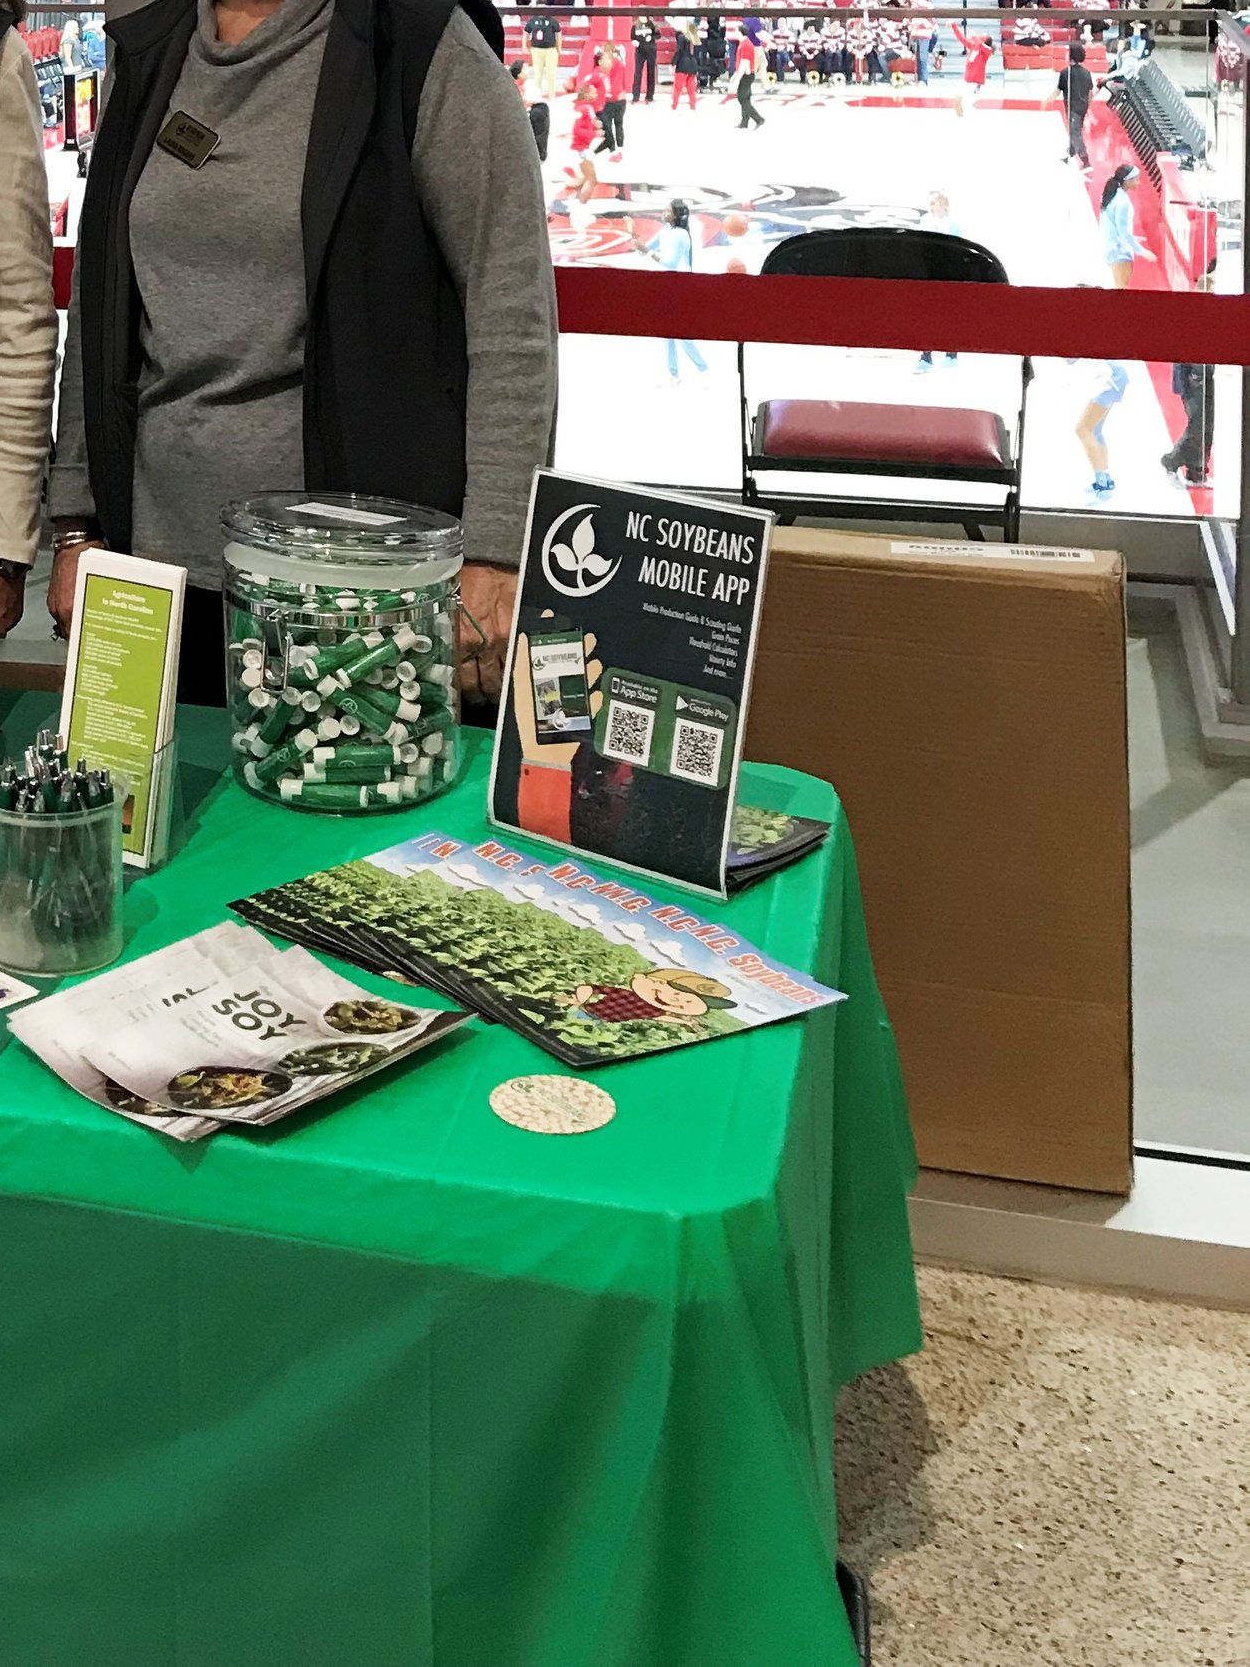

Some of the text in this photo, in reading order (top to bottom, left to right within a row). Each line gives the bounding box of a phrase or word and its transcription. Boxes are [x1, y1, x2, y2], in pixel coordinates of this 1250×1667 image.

[625, 510, 756, 565] NC SOYBEANS
[638, 555, 751, 606] MOBILE APP
[619, 685, 659, 704] App Store
[688, 704, 730, 723] Google Play
[473, 841, 524, 871] N.C.
[727, 952, 828, 1005] Soybeans
[211, 998, 289, 1042] SOY
[233, 989, 308, 1030] JOY
